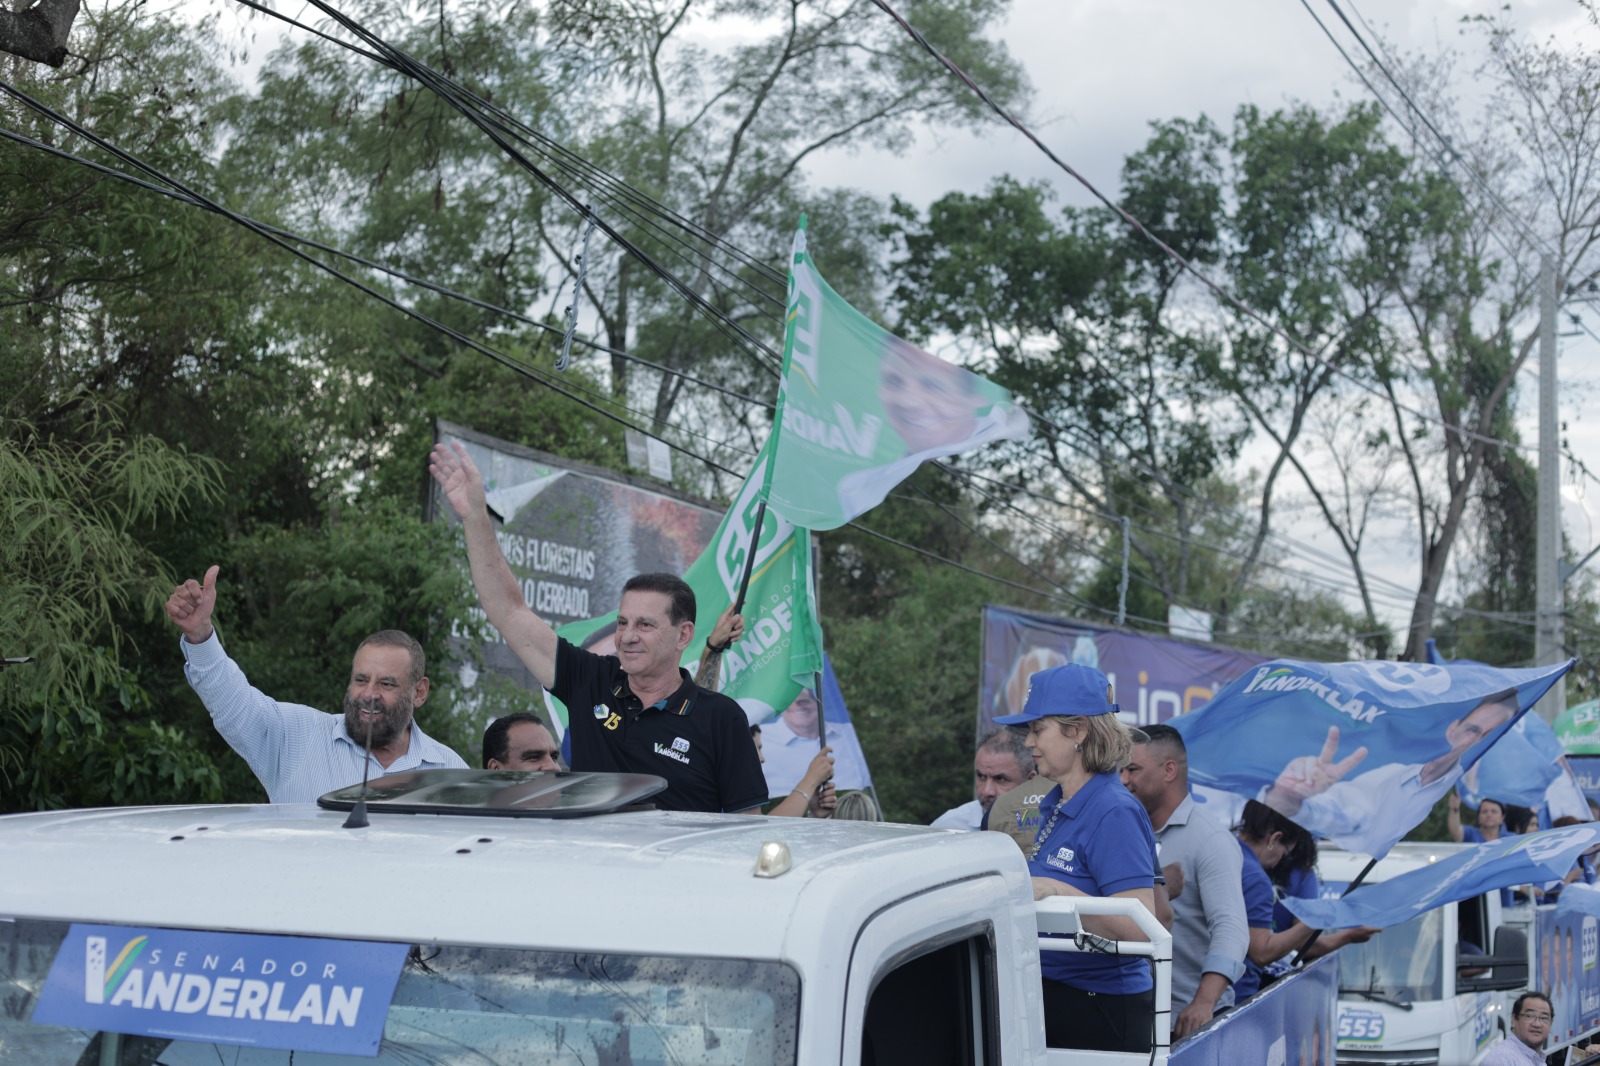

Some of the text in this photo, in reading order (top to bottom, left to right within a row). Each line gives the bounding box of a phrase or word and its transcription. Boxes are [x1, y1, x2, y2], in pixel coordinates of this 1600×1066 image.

[526, 537, 596, 581] FLORESTAIS
[1242, 666, 1388, 724] VANDERLAN
[603, 711, 622, 731] 15
[654, 742, 690, 765] VANDERLAN
[673, 739, 688, 751] 555
[1058, 849, 1074, 860] 555
[148, 948, 337, 980] SENADOR
[85, 934, 364, 1028] VANDERLAN
[1338, 1017, 1383, 1038] 555
